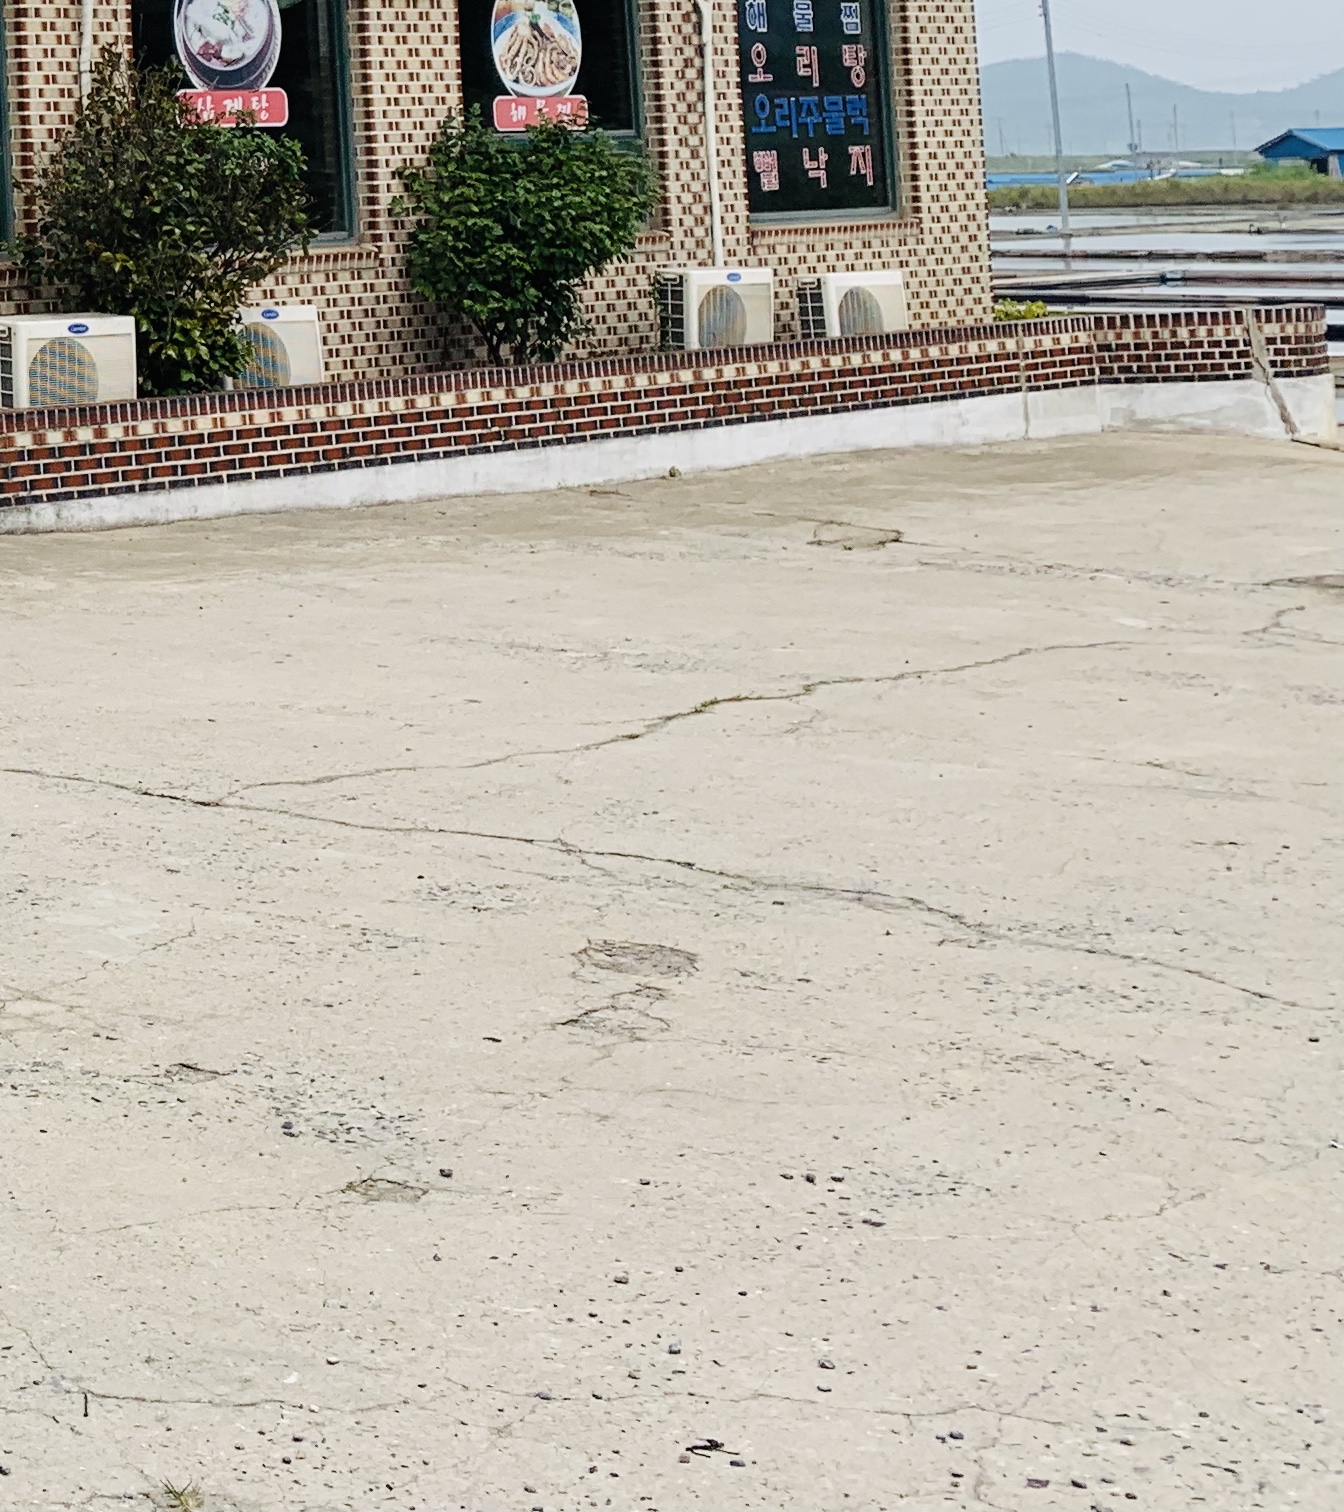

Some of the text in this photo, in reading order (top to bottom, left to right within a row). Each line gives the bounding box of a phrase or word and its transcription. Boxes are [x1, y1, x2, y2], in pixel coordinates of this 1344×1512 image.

[745, 0, 861, 35] 해물찜
[748, 42, 867, 88] 오리탕
[752, 93, 870, 138] 오리주물럭
